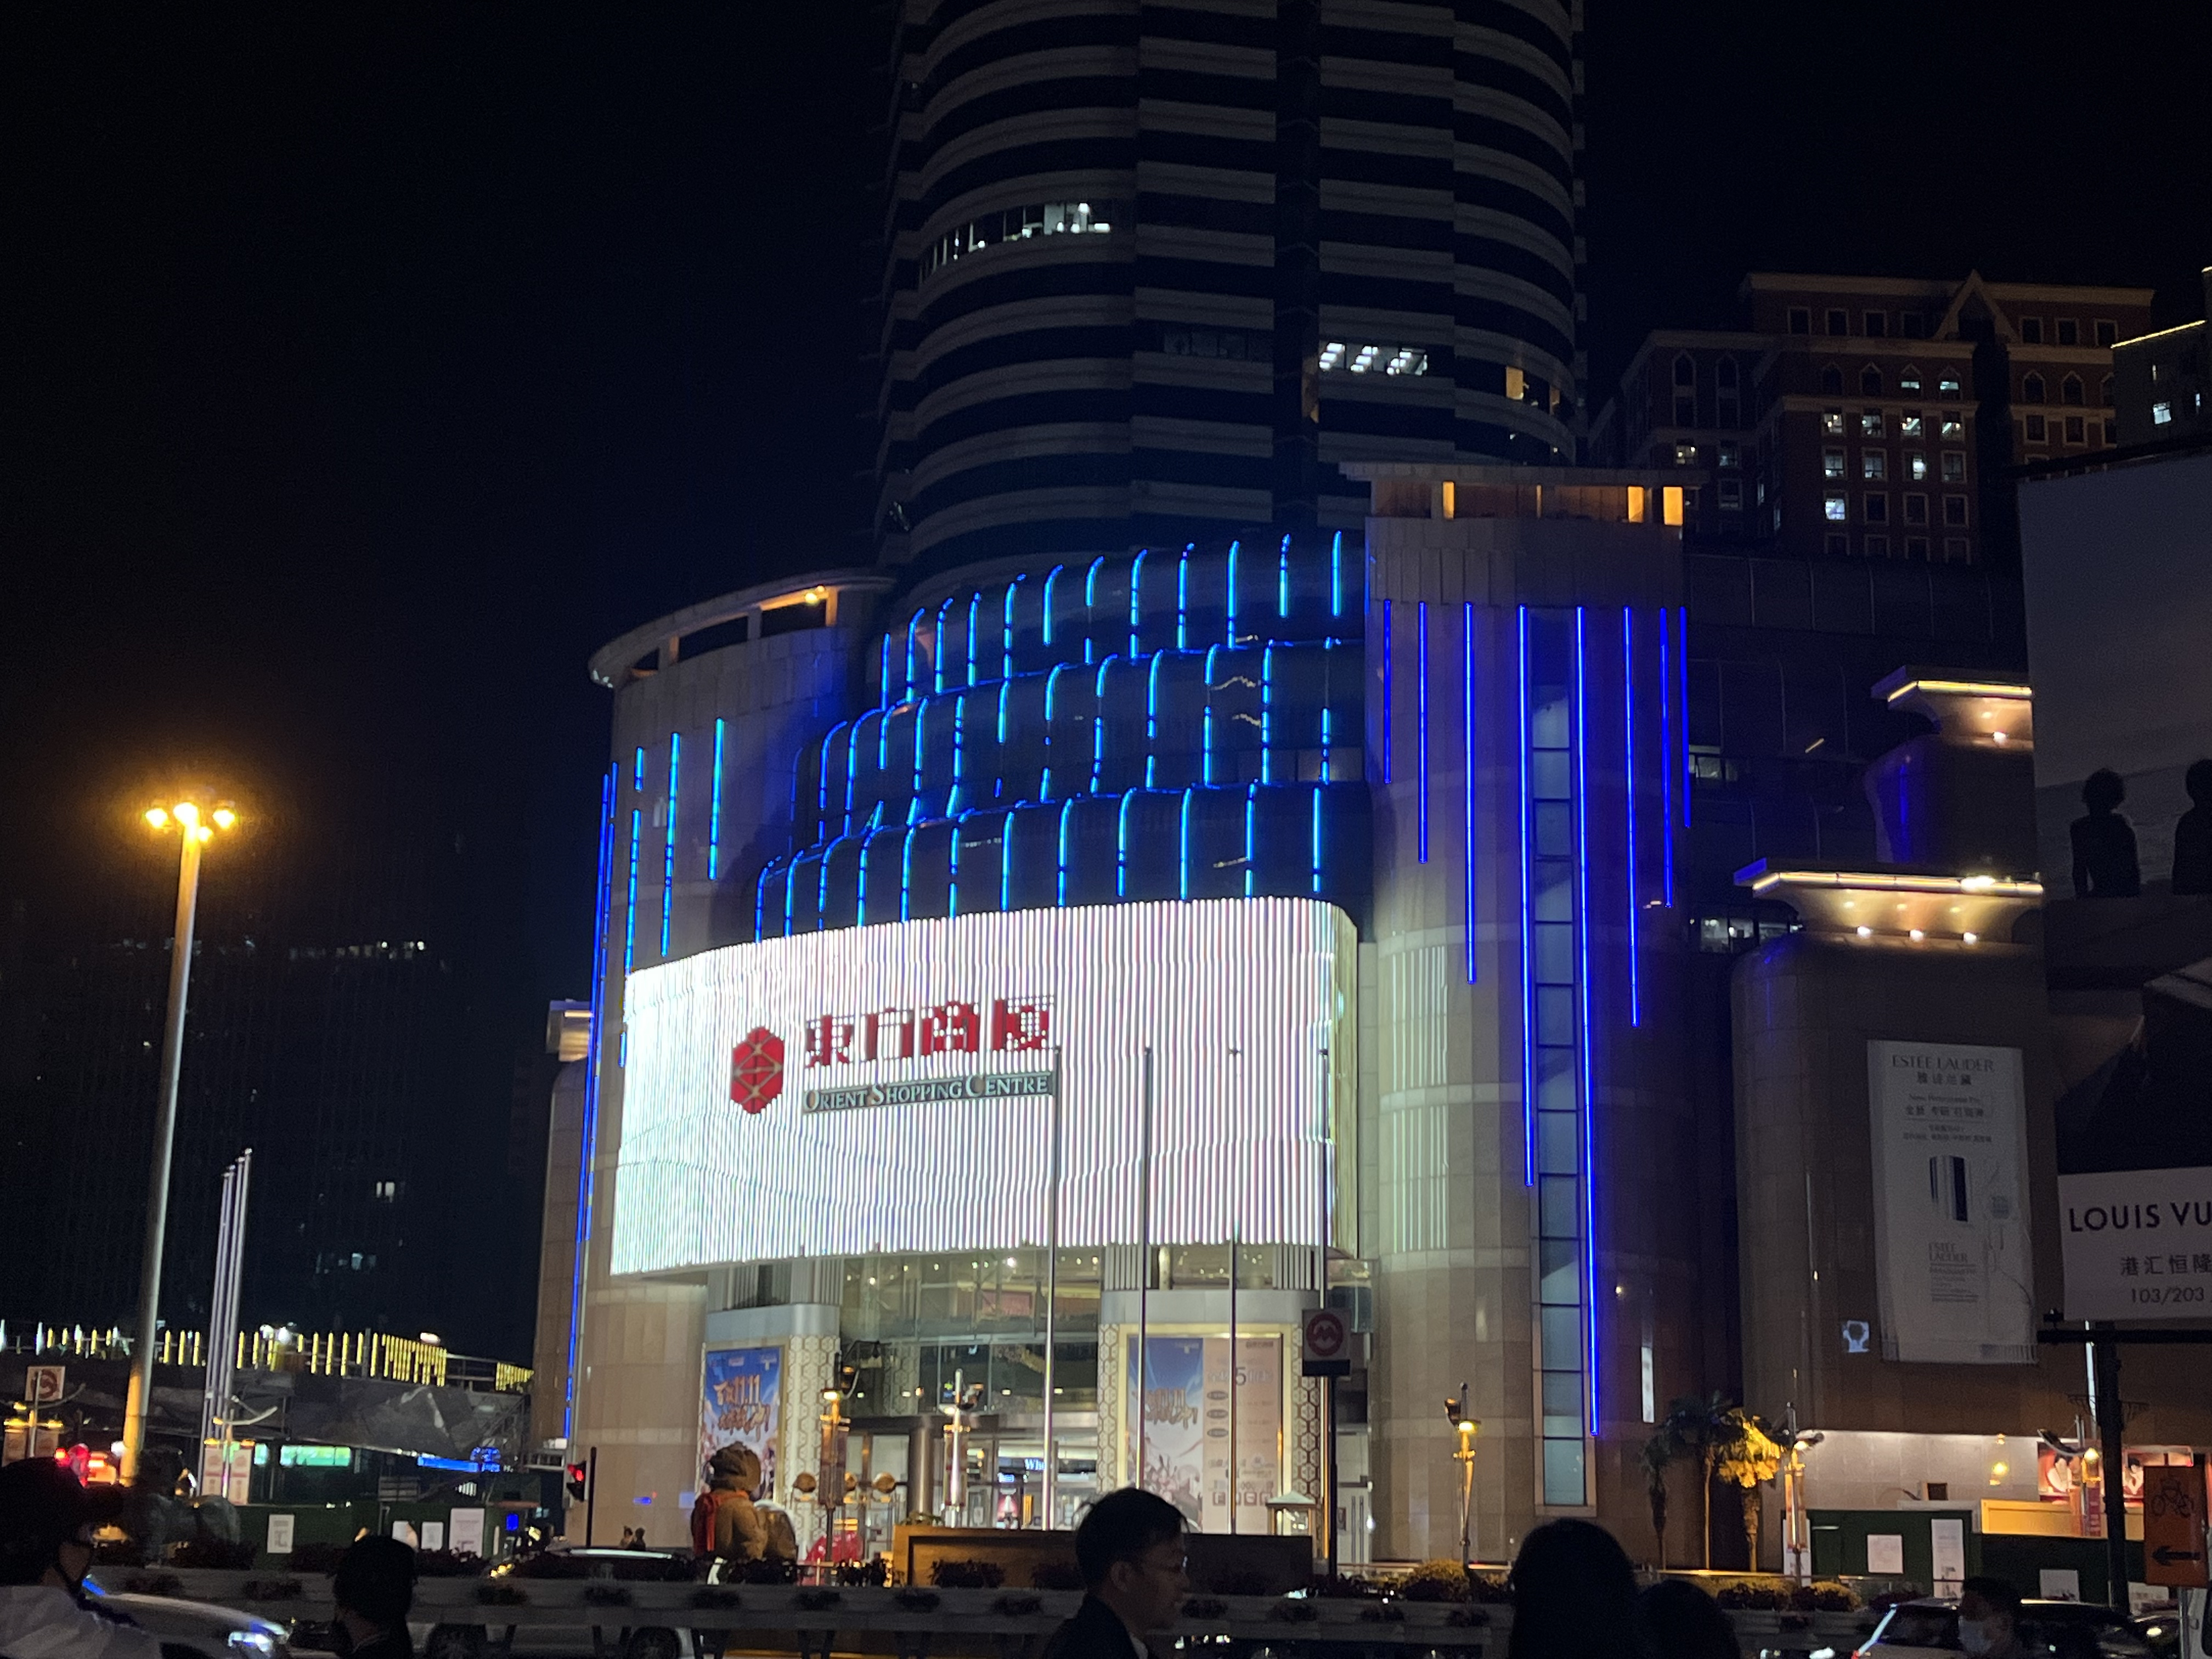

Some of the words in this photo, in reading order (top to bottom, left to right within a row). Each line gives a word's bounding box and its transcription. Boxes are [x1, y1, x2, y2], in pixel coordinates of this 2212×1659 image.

[1937, 1058, 1995, 1072] LAUDER
[870, 1081, 962, 1105] SHOPPING
[966, 1074, 1047, 1097] CENTRE
[2069, 1204, 2160, 1232] LOUIS
[2120, 1254, 2212, 1276] 港汇恒隆
[2131, 1287, 2204, 1305] 103/203
